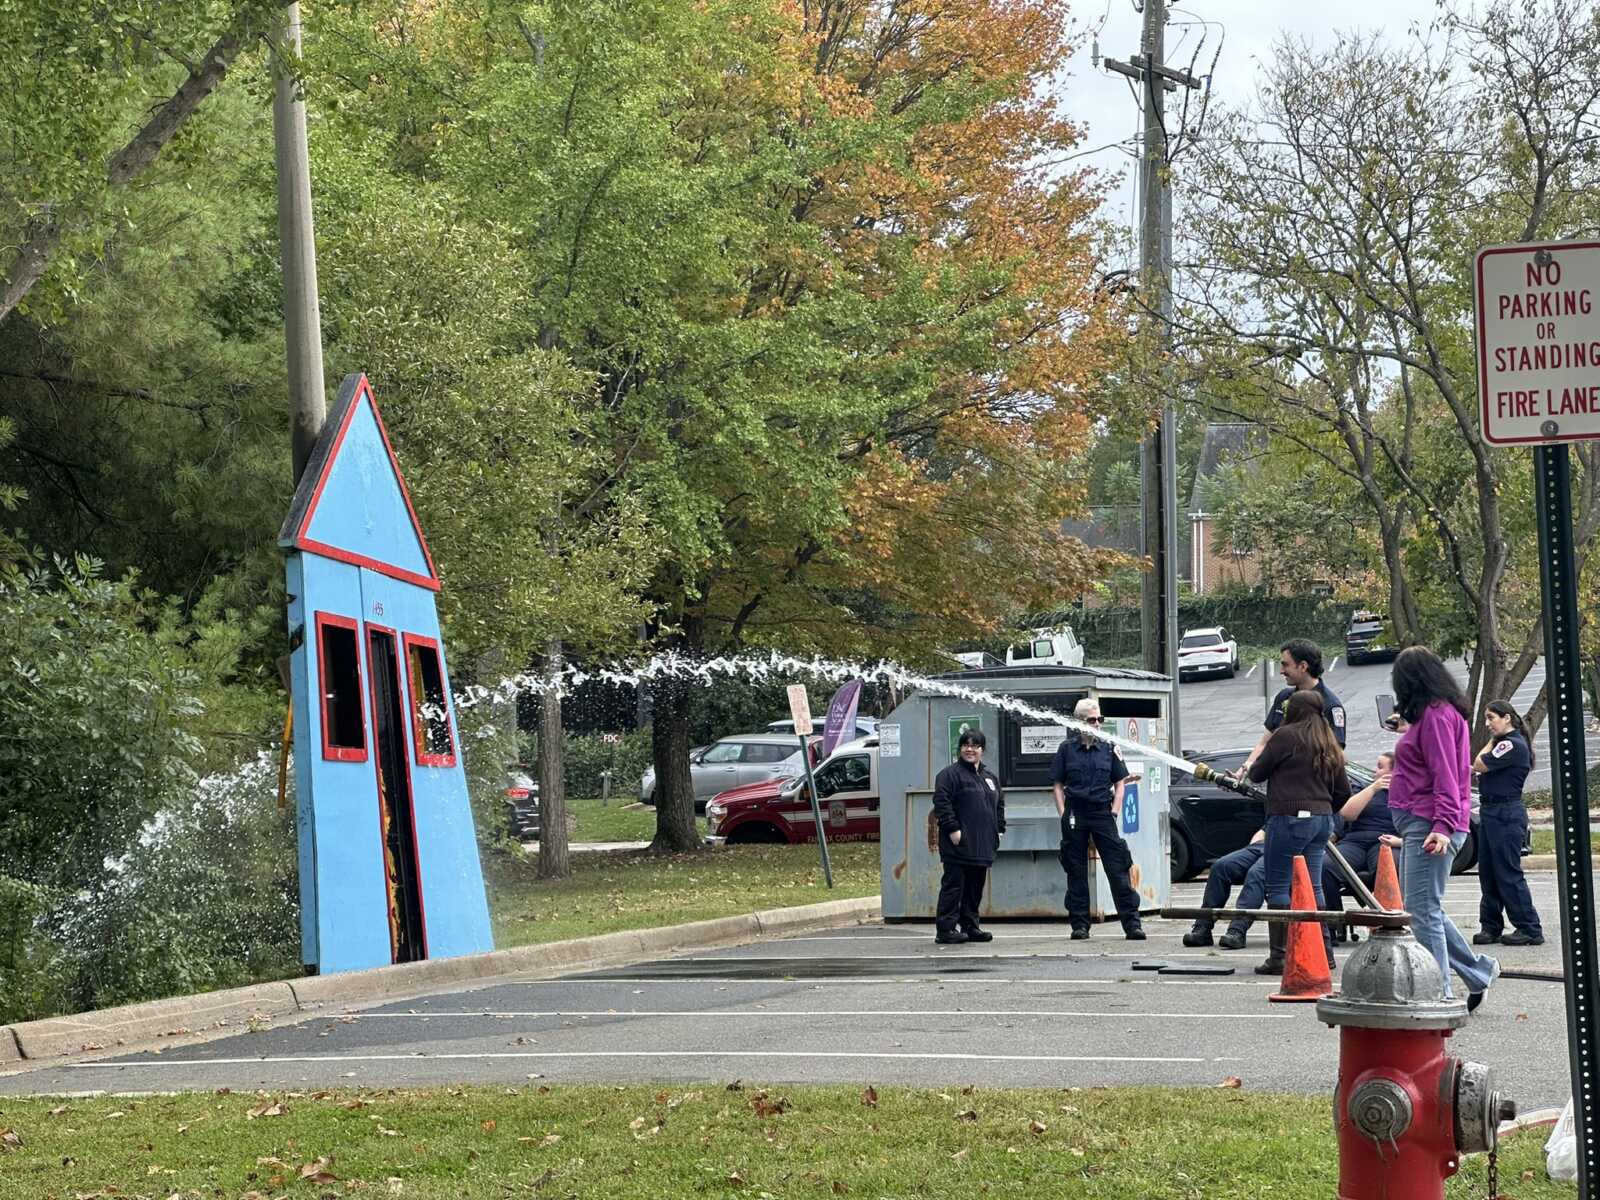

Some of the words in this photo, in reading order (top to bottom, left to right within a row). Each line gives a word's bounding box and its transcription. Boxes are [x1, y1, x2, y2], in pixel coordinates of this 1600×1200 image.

[1526, 261, 1561, 287] NO
[1499, 290, 1592, 319] PARKING
[1536, 322, 1556, 340] OR
[1495, 343, 1600, 372] STANDING
[1497, 390, 1540, 418] FIRE
[1547, 387, 1600, 416] LANE
[603, 734, 619, 743] FDC
[835, 832, 863, 842] COUNTY
